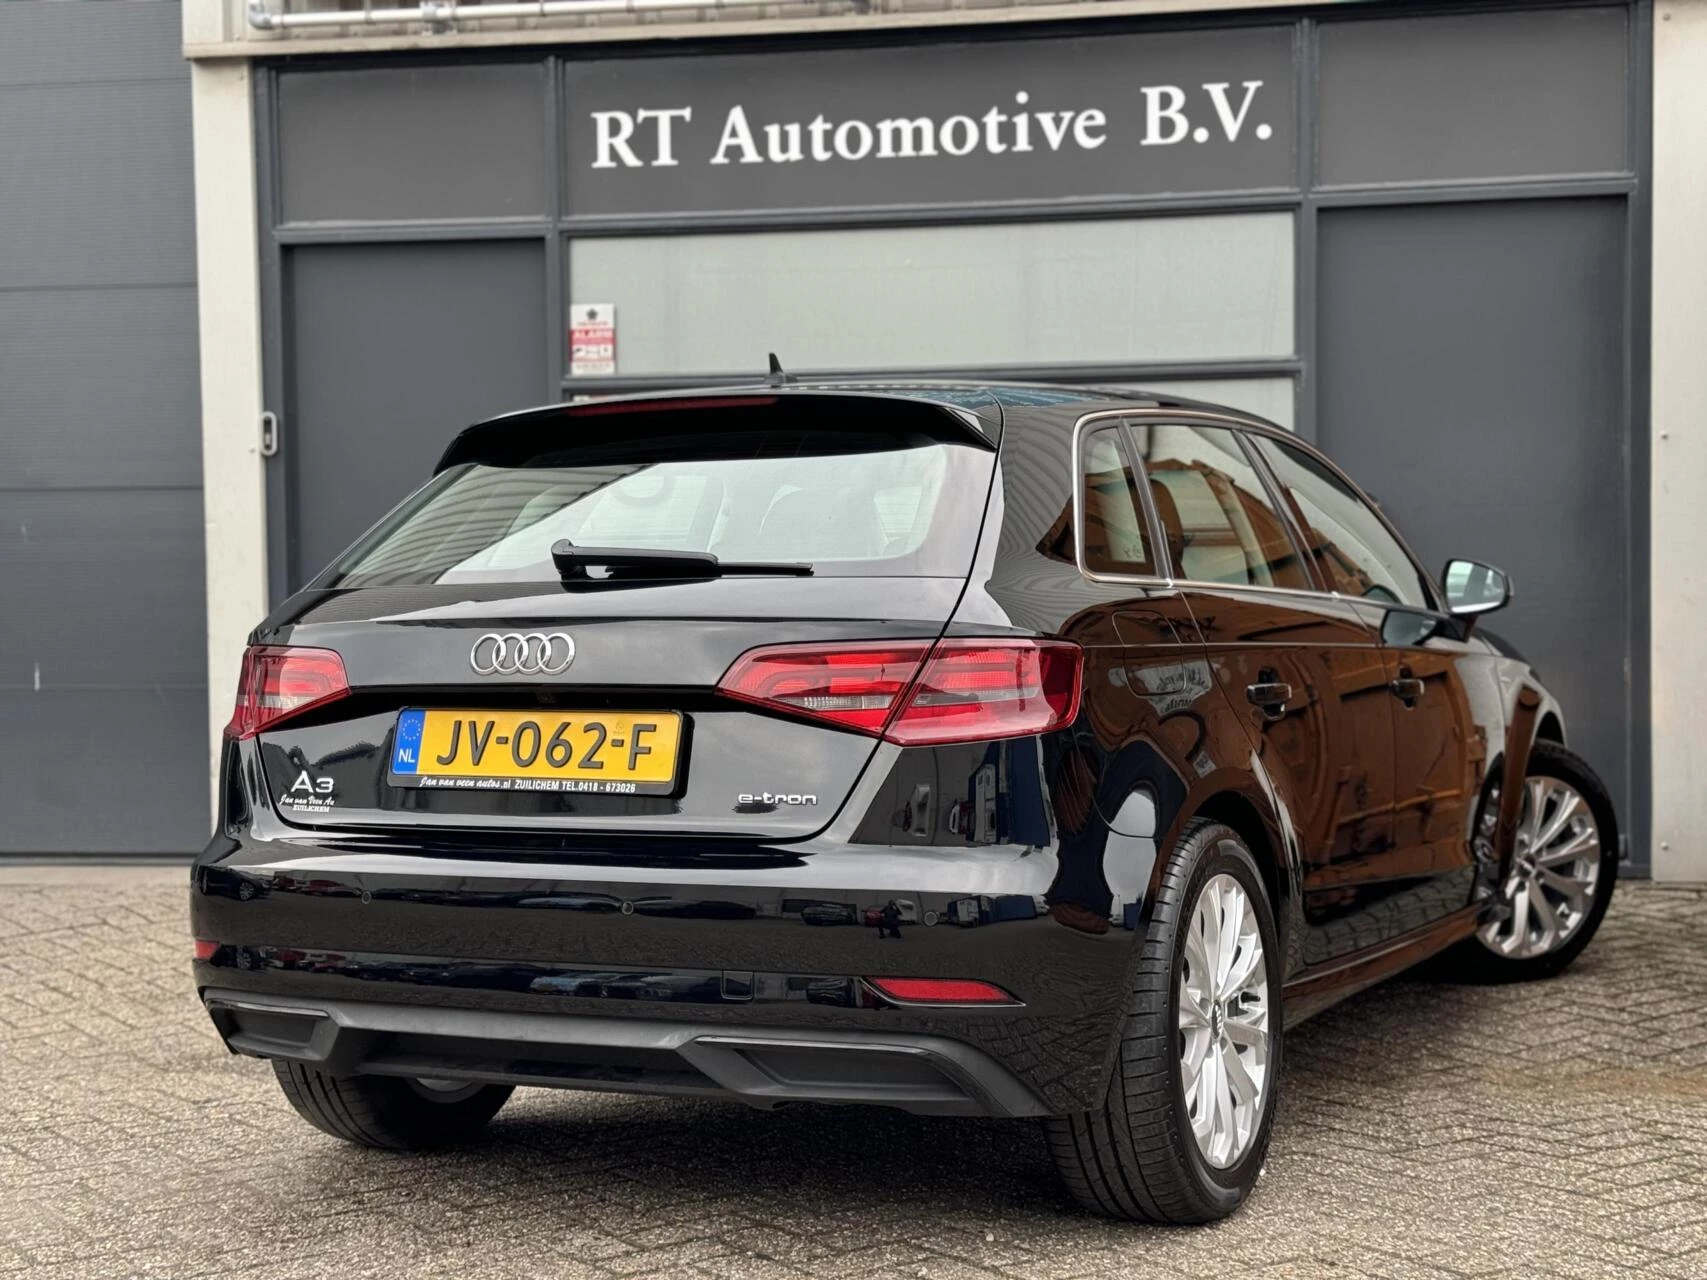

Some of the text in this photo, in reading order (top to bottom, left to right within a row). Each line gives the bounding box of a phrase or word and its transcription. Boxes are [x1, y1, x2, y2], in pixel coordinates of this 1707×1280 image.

[590, 80, 1272, 168] RT Automotive B.V.
[436, 720, 657, 771] JV-062-F
[398, 748, 416, 764] NL
[290, 769, 335, 793] A3
[419, 776, 437, 788] Jan
[438, 779, 455, 787] van
[456, 779, 475, 788] veen
[514, 780, 560, 791] ZUILICHEM
[605, 782, 636, 793] 673026
[738, 792, 817, 805] e-tron
